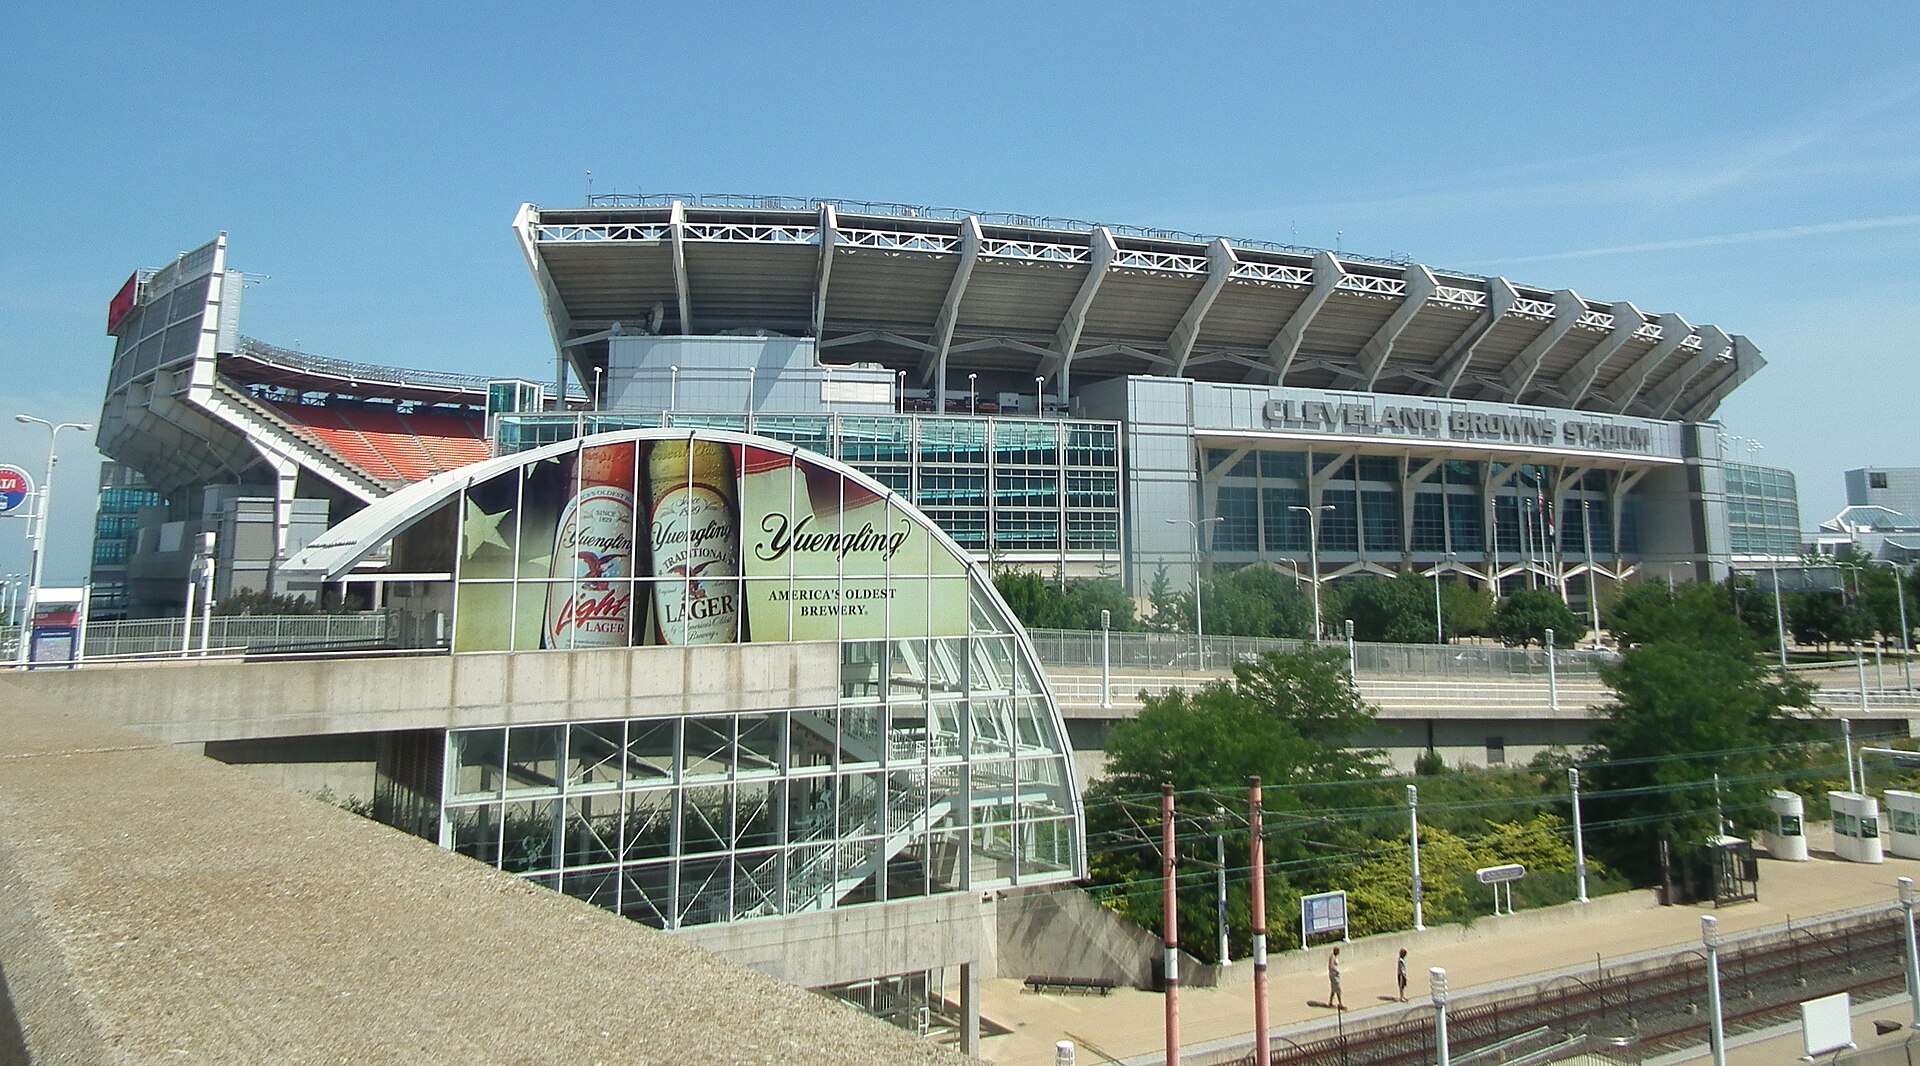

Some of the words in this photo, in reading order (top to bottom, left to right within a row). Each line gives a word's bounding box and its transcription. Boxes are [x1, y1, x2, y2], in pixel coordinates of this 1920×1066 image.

[1263, 400, 1442, 431] CLEVELAND
[1449, 411, 1556, 439] BROWNS
[1563, 421, 1651, 447] STADIUM
[0, 478, 17, 489] TA
[651, 519, 732, 552] Yuengling
[755, 512, 911, 562] Yuengling
[665, 595, 735, 623] LAGER
[768, 589, 840, 601] AMERICA'S
[845, 589, 897, 599] OLDEST
[555, 588, 632, 636] Light
[585, 621, 625, 633] LAGER
